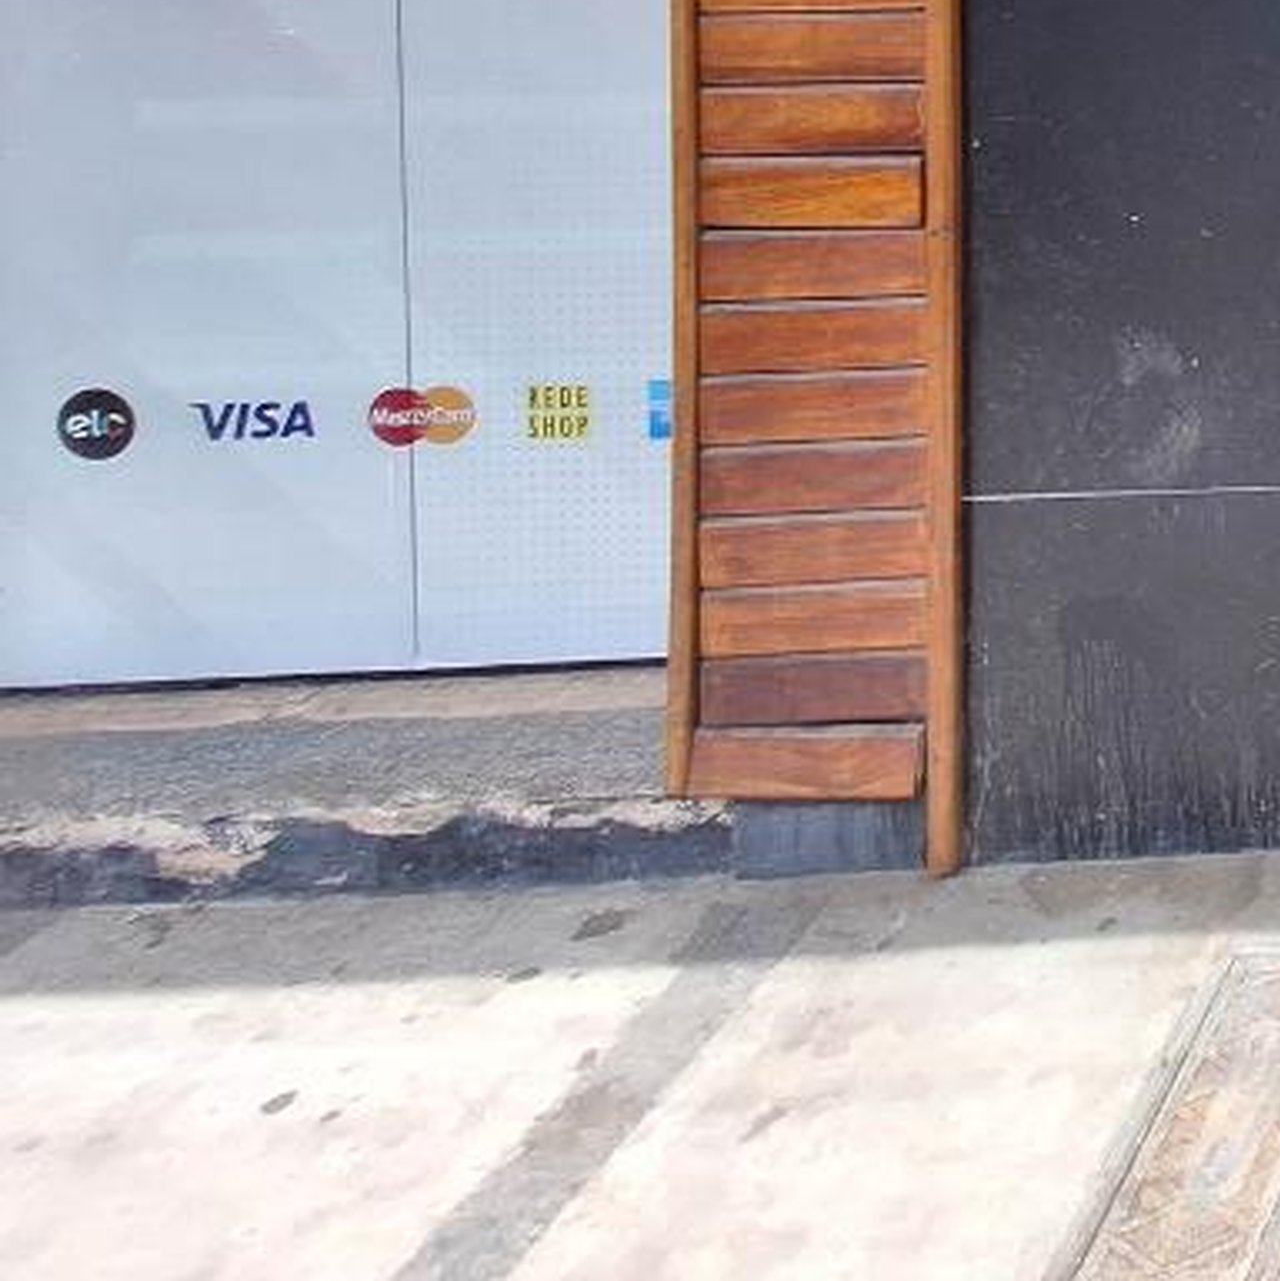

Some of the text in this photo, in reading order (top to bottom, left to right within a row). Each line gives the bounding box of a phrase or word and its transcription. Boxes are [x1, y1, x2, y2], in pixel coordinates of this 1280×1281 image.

[528, 386, 588, 408] REDE
[188, 401, 315, 441] VISA
[527, 416, 589, 439] SHOP
